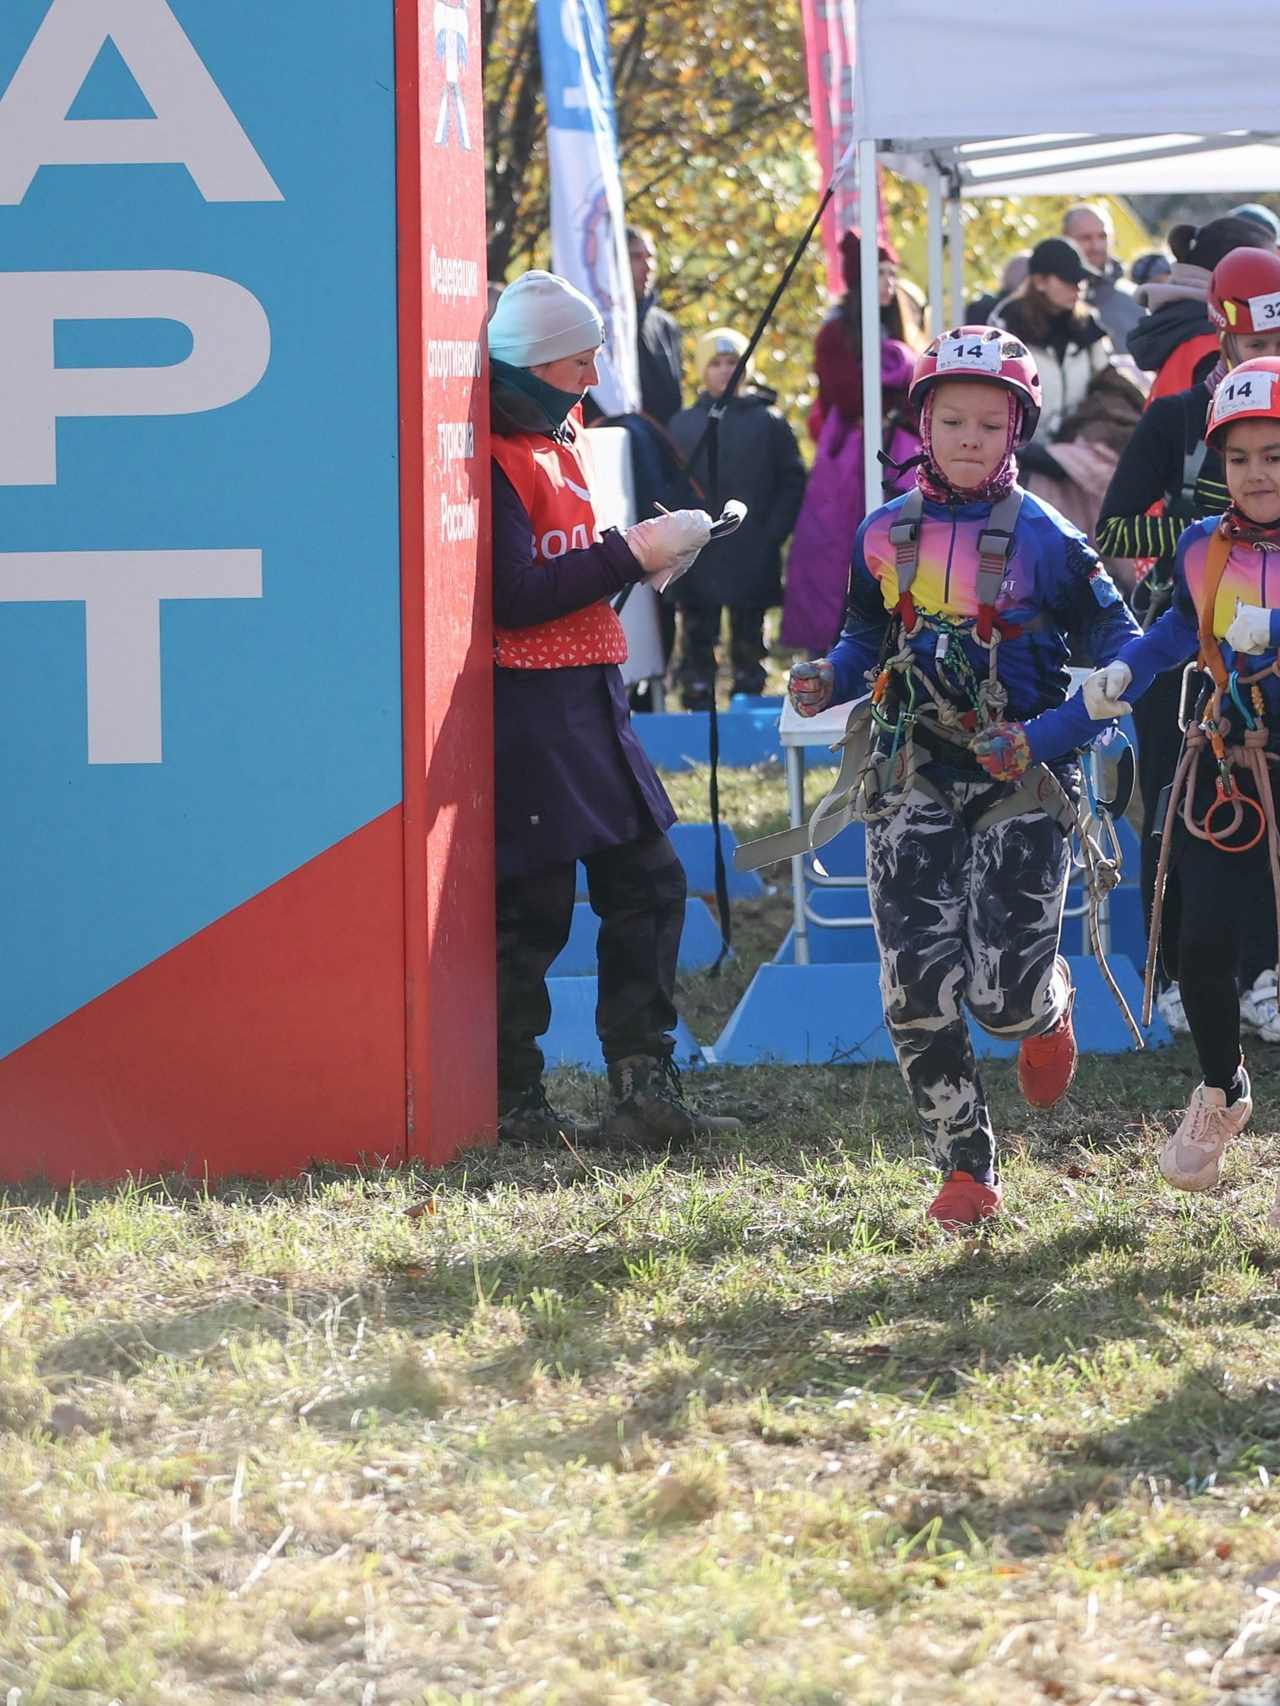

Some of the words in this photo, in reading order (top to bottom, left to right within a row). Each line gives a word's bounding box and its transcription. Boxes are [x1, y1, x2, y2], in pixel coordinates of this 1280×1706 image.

[429, 243, 478, 308] Федерация
[427, 338, 481, 389] спортивного
[953, 344, 983, 359] 14
[1225, 381, 1253, 401] 14
[437, 421, 474, 474] туризма
[440, 492, 476, 542] России
